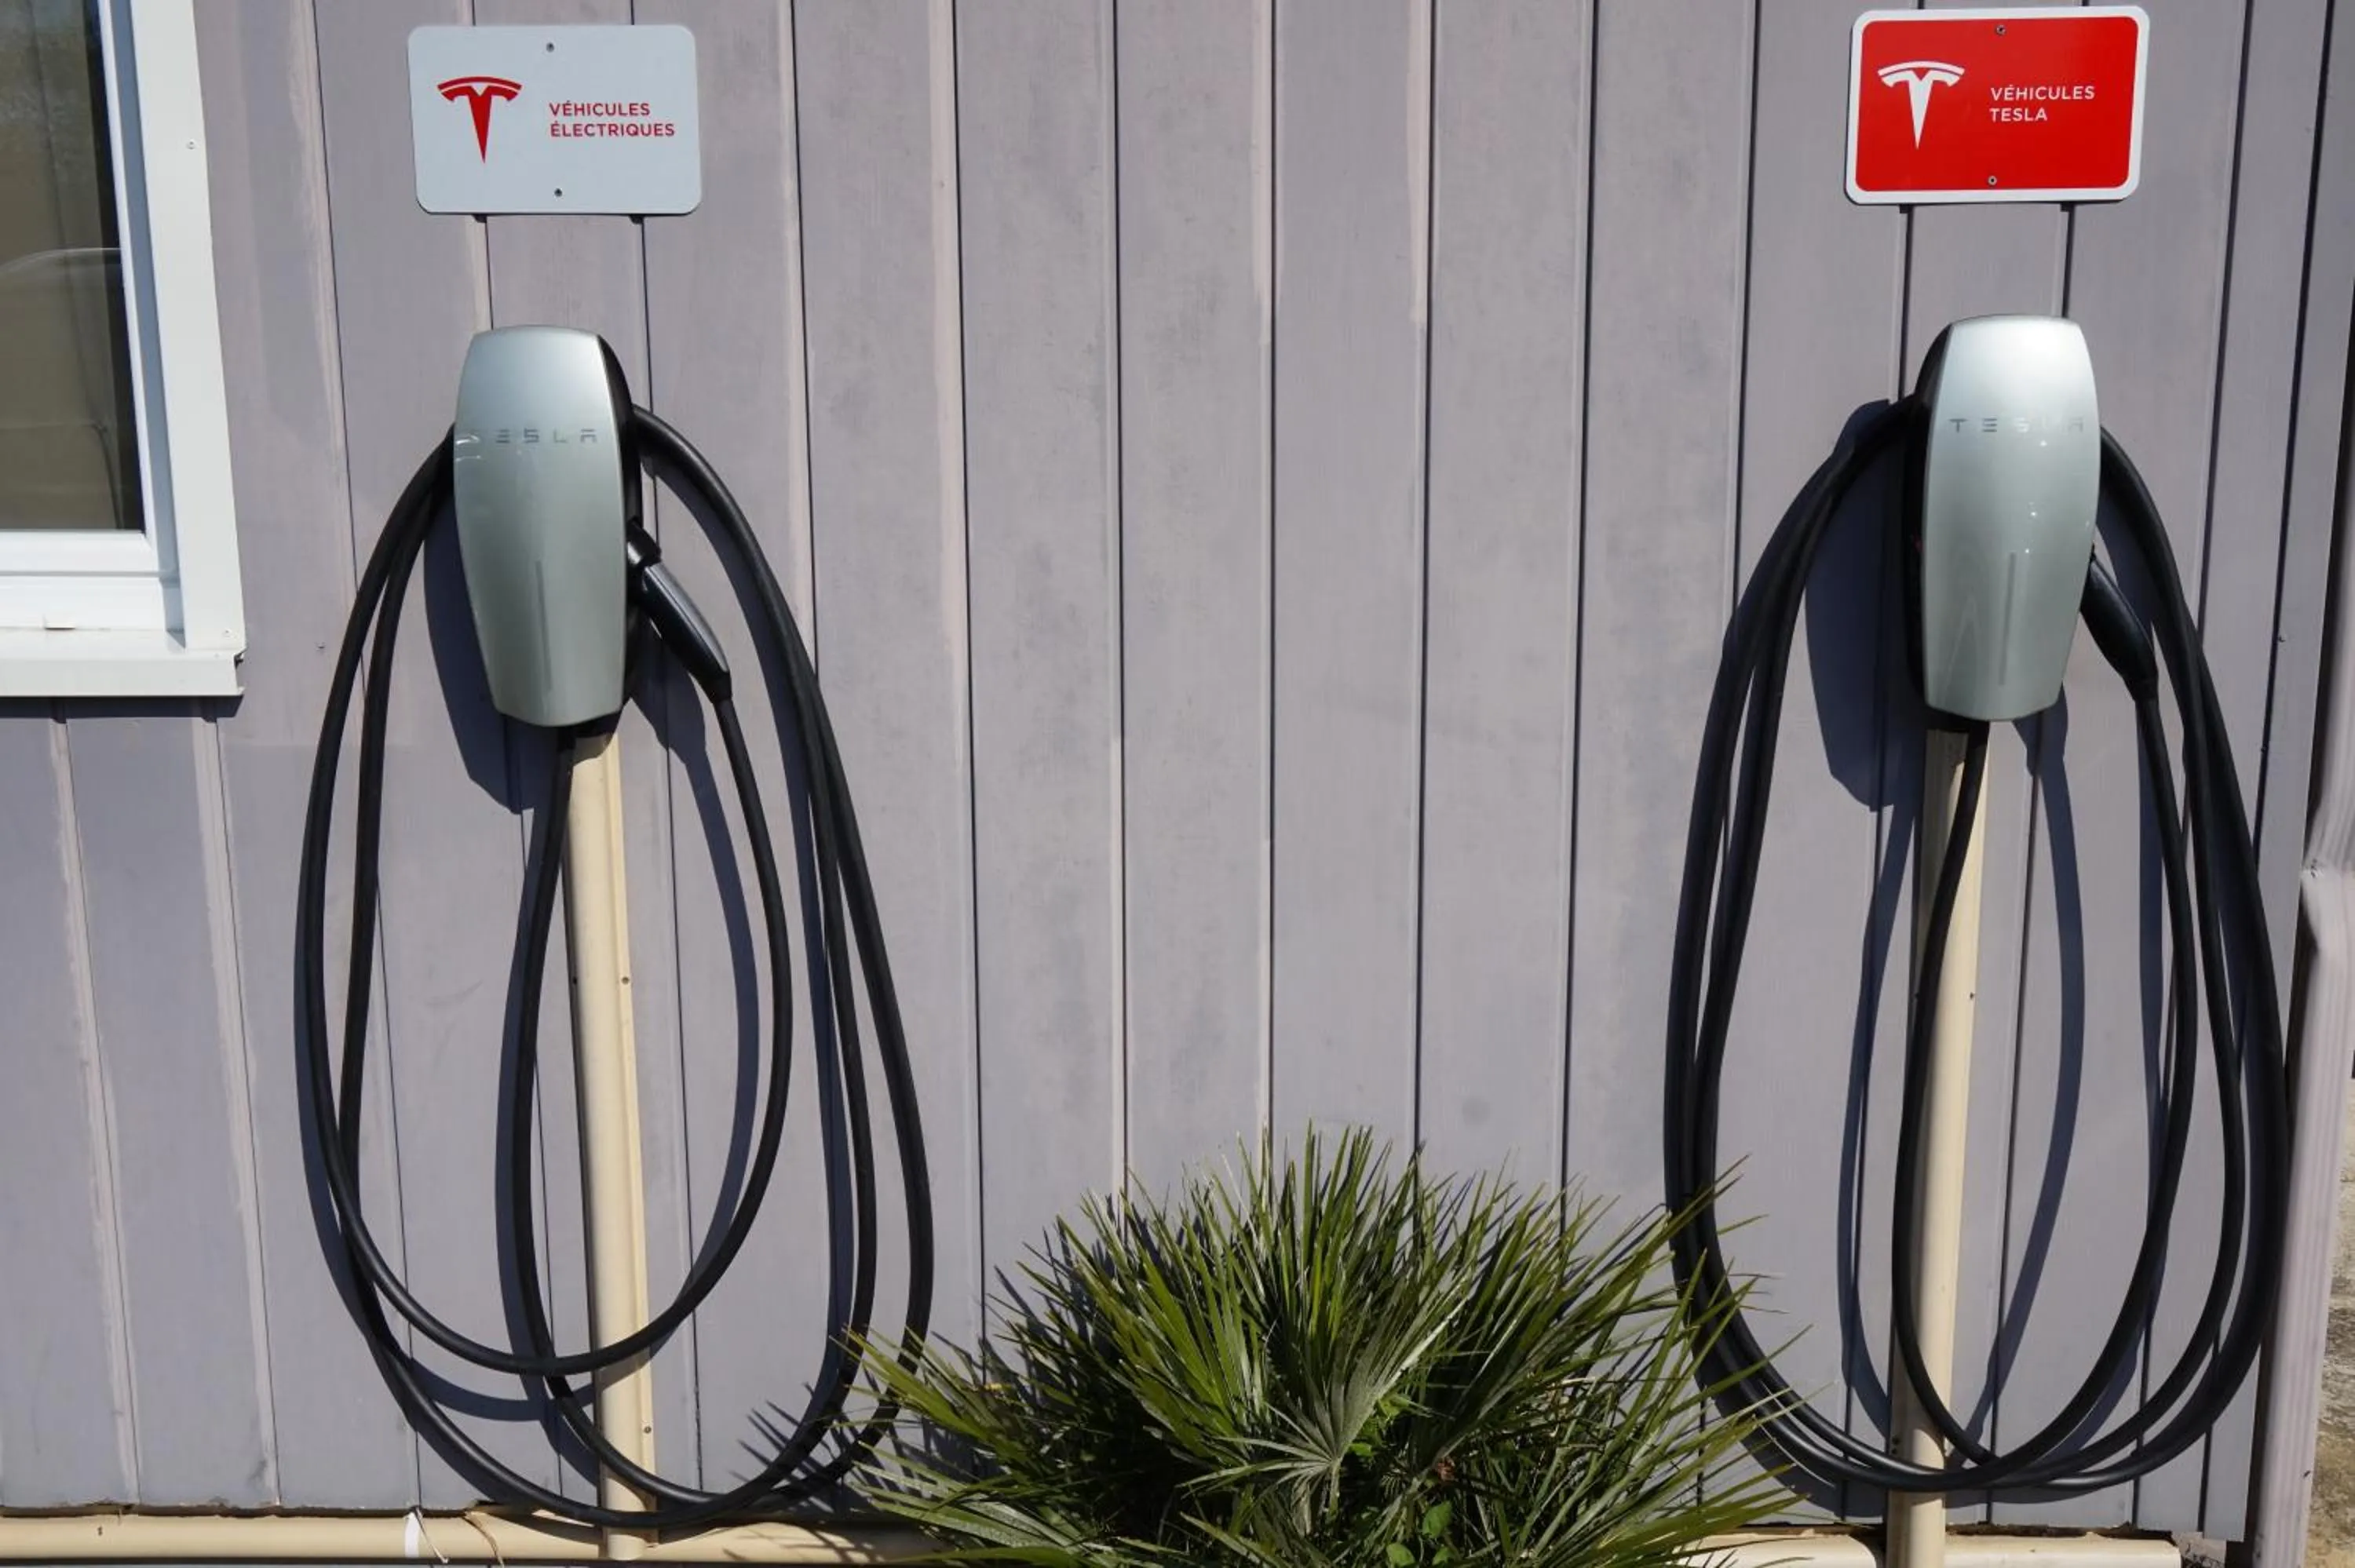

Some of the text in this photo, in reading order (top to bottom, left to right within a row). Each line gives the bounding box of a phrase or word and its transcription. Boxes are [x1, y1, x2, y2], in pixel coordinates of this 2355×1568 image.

[1990, 86, 2095, 101] VÉHICULES
[550, 100, 650, 116] VÉHICULES
[1990, 108, 2048, 122] TESLA
[550, 121, 675, 137] ÉLECTRIQUES
[469, 428, 597, 444] ESLA
